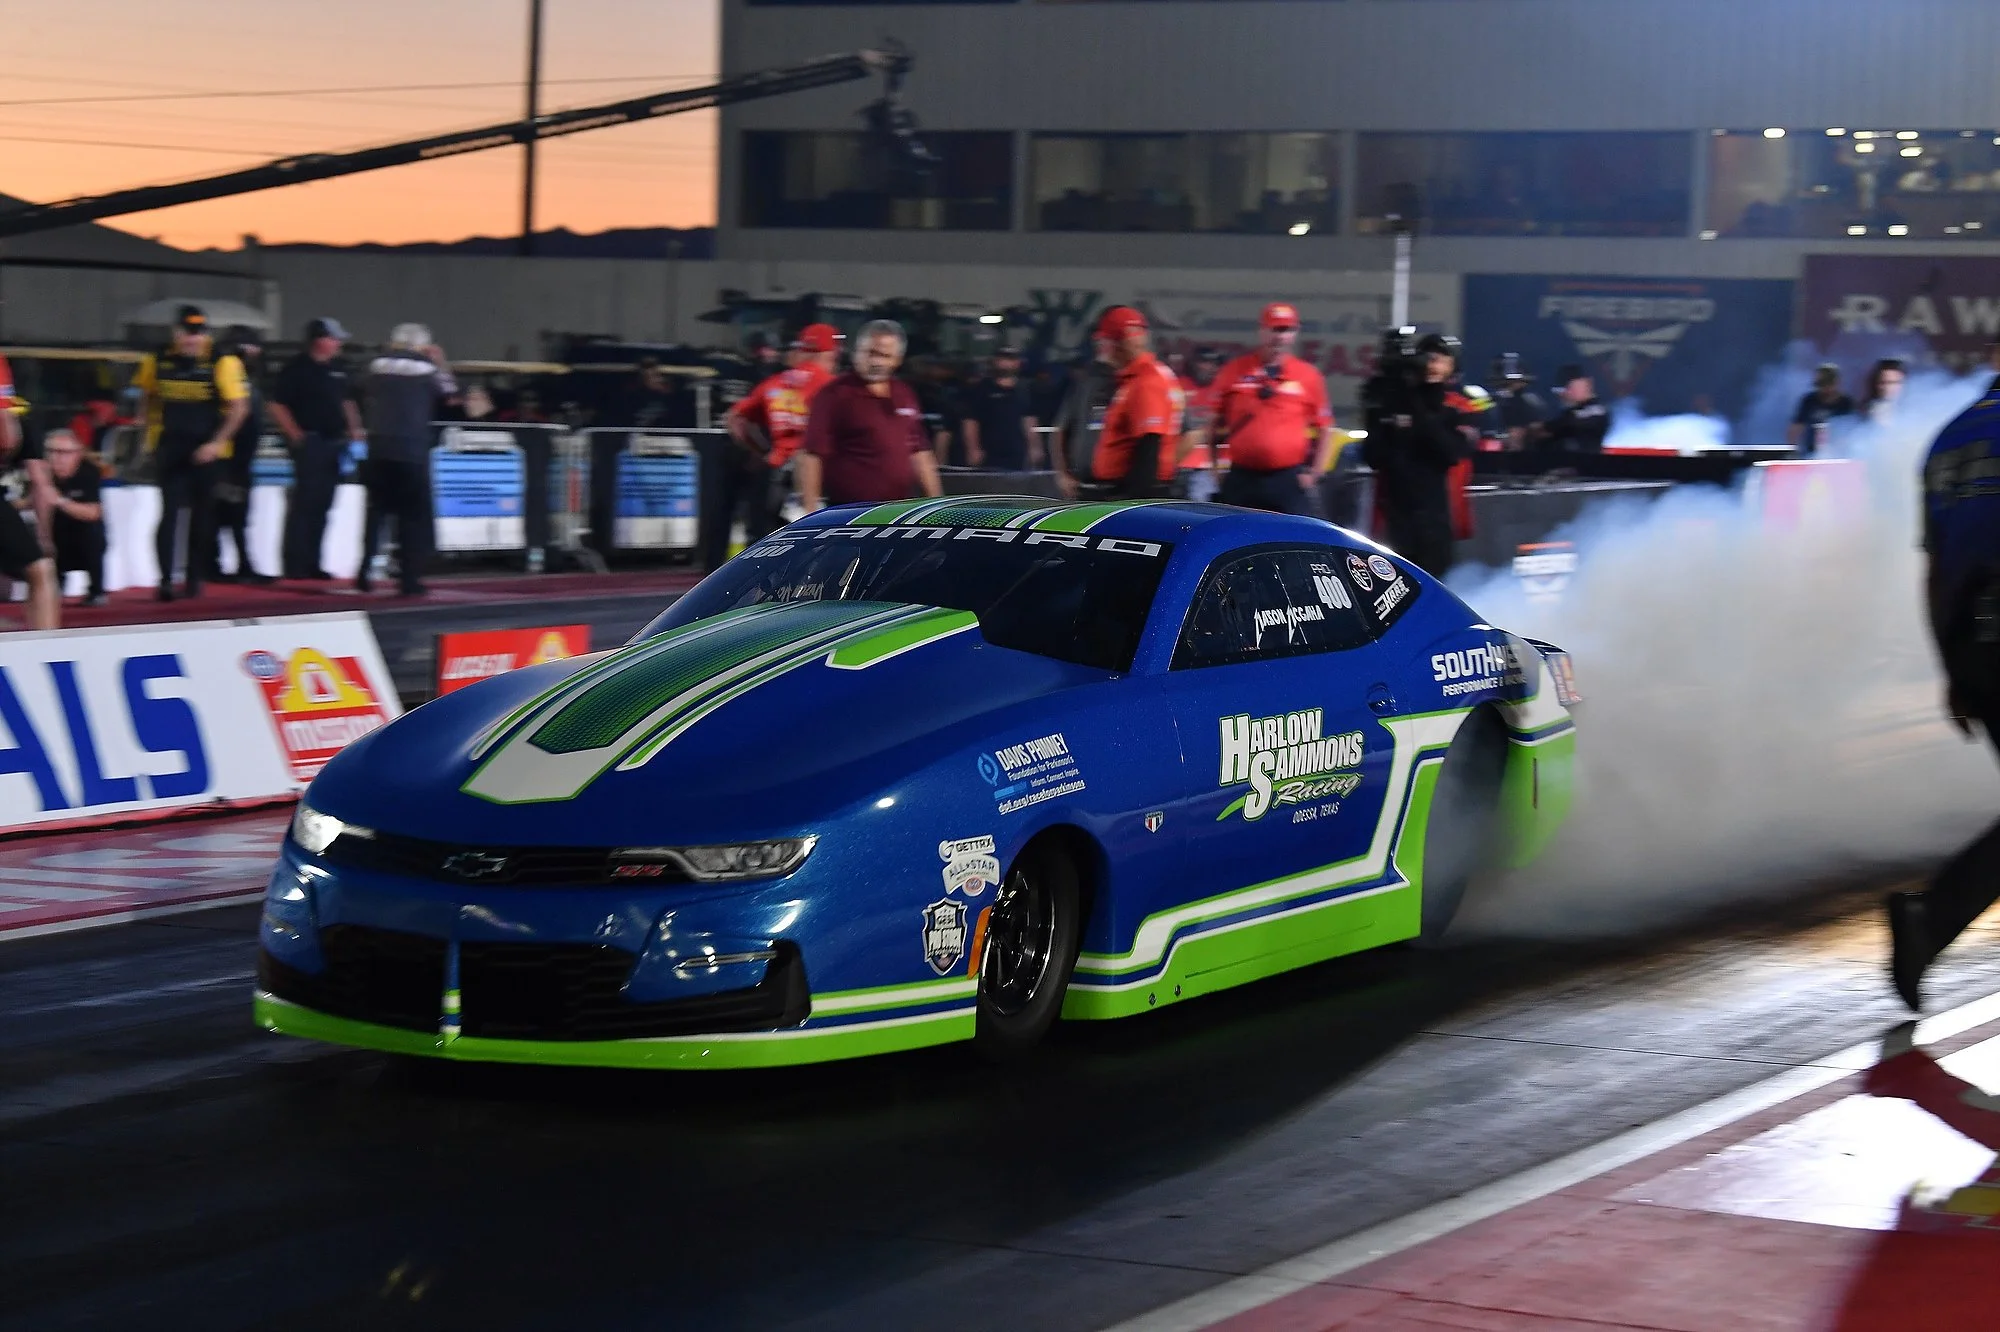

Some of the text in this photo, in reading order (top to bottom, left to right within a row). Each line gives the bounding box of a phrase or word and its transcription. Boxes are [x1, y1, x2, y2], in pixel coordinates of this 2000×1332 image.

[763, 527, 1162, 557] CAMARO
[1312, 575, 1353, 609] 400
[1253, 607, 1287, 649] JASON
[1442, 677, 1500, 697] PERFORMANCE
[995, 732, 1069, 772] DAVIS PHINNEY
[1220, 708, 1322, 785] HARLOW
[1007, 764, 1040, 781] Foundation
[1038, 761, 1050, 773] for
[1243, 732, 1364, 820] SAMMONS
[1272, 774, 1361, 808] Racing
[1319, 801, 1340, 818] TEXAS
[955, 836, 993, 853] GETTRX
